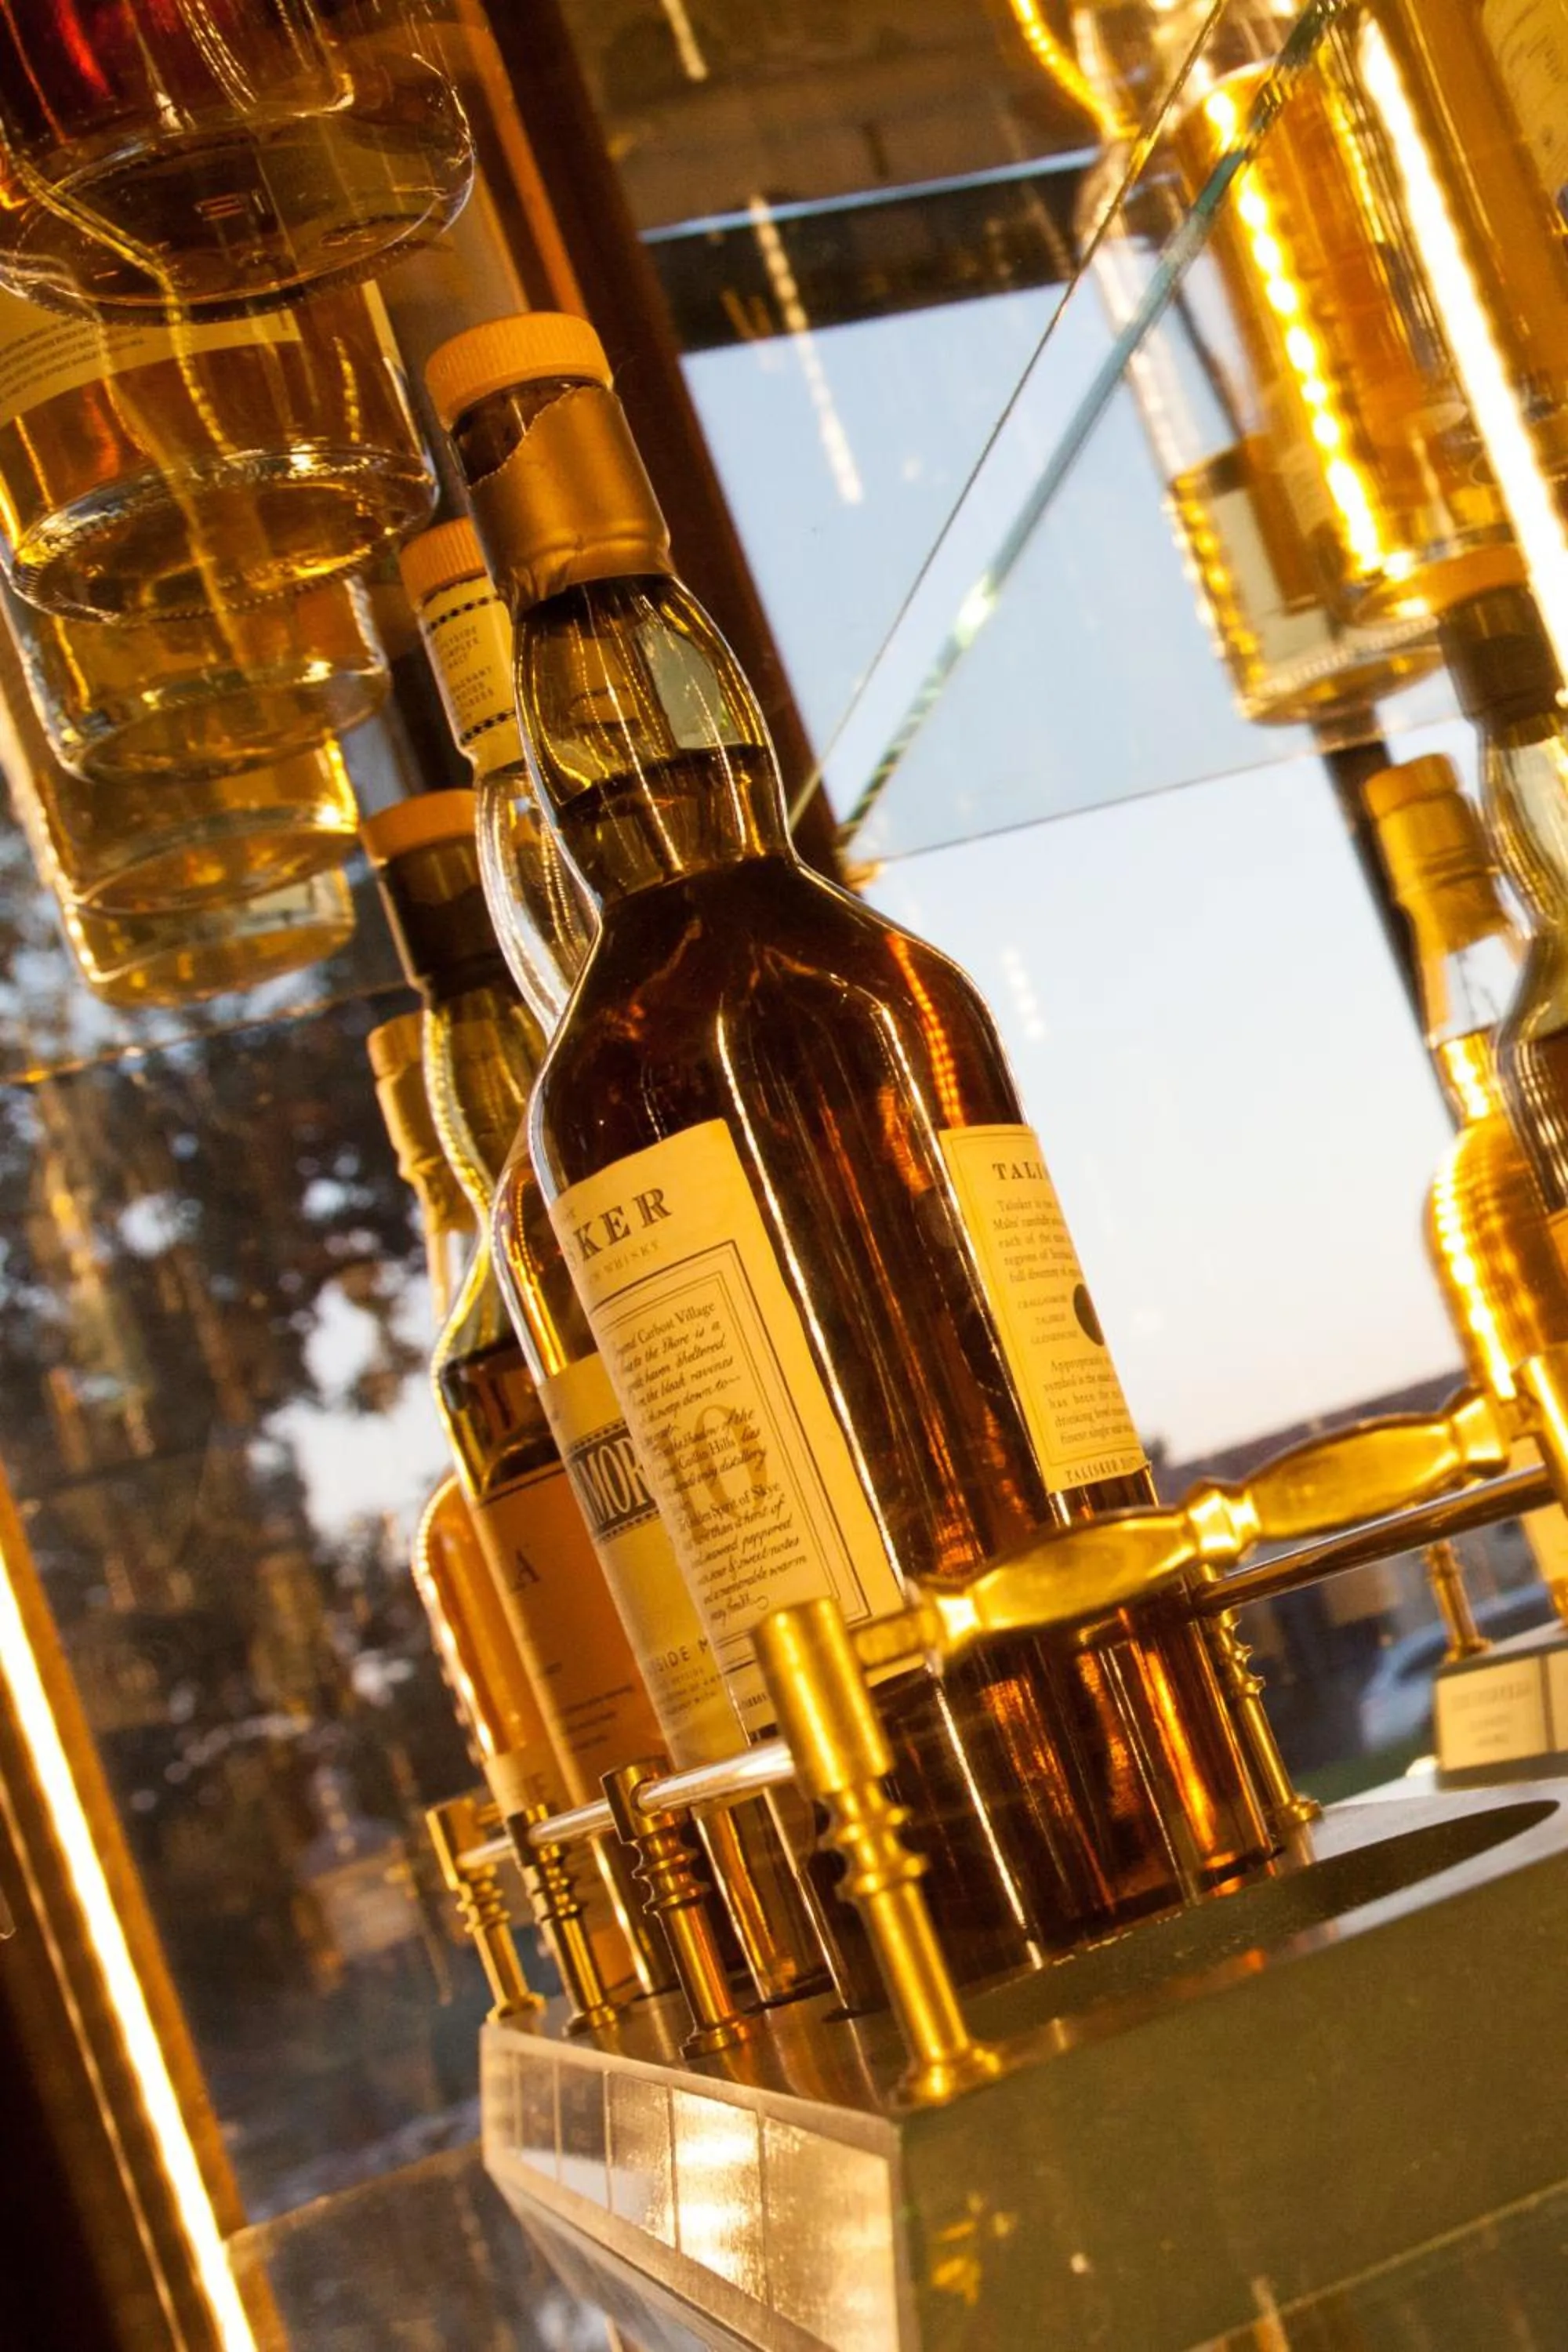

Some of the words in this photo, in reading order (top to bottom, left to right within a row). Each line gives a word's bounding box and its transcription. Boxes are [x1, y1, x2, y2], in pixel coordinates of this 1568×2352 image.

[991, 1161, 1044, 1181] TALI
[572, 1189, 672, 1261] KER
[674, 1303, 715, 1323] Village
